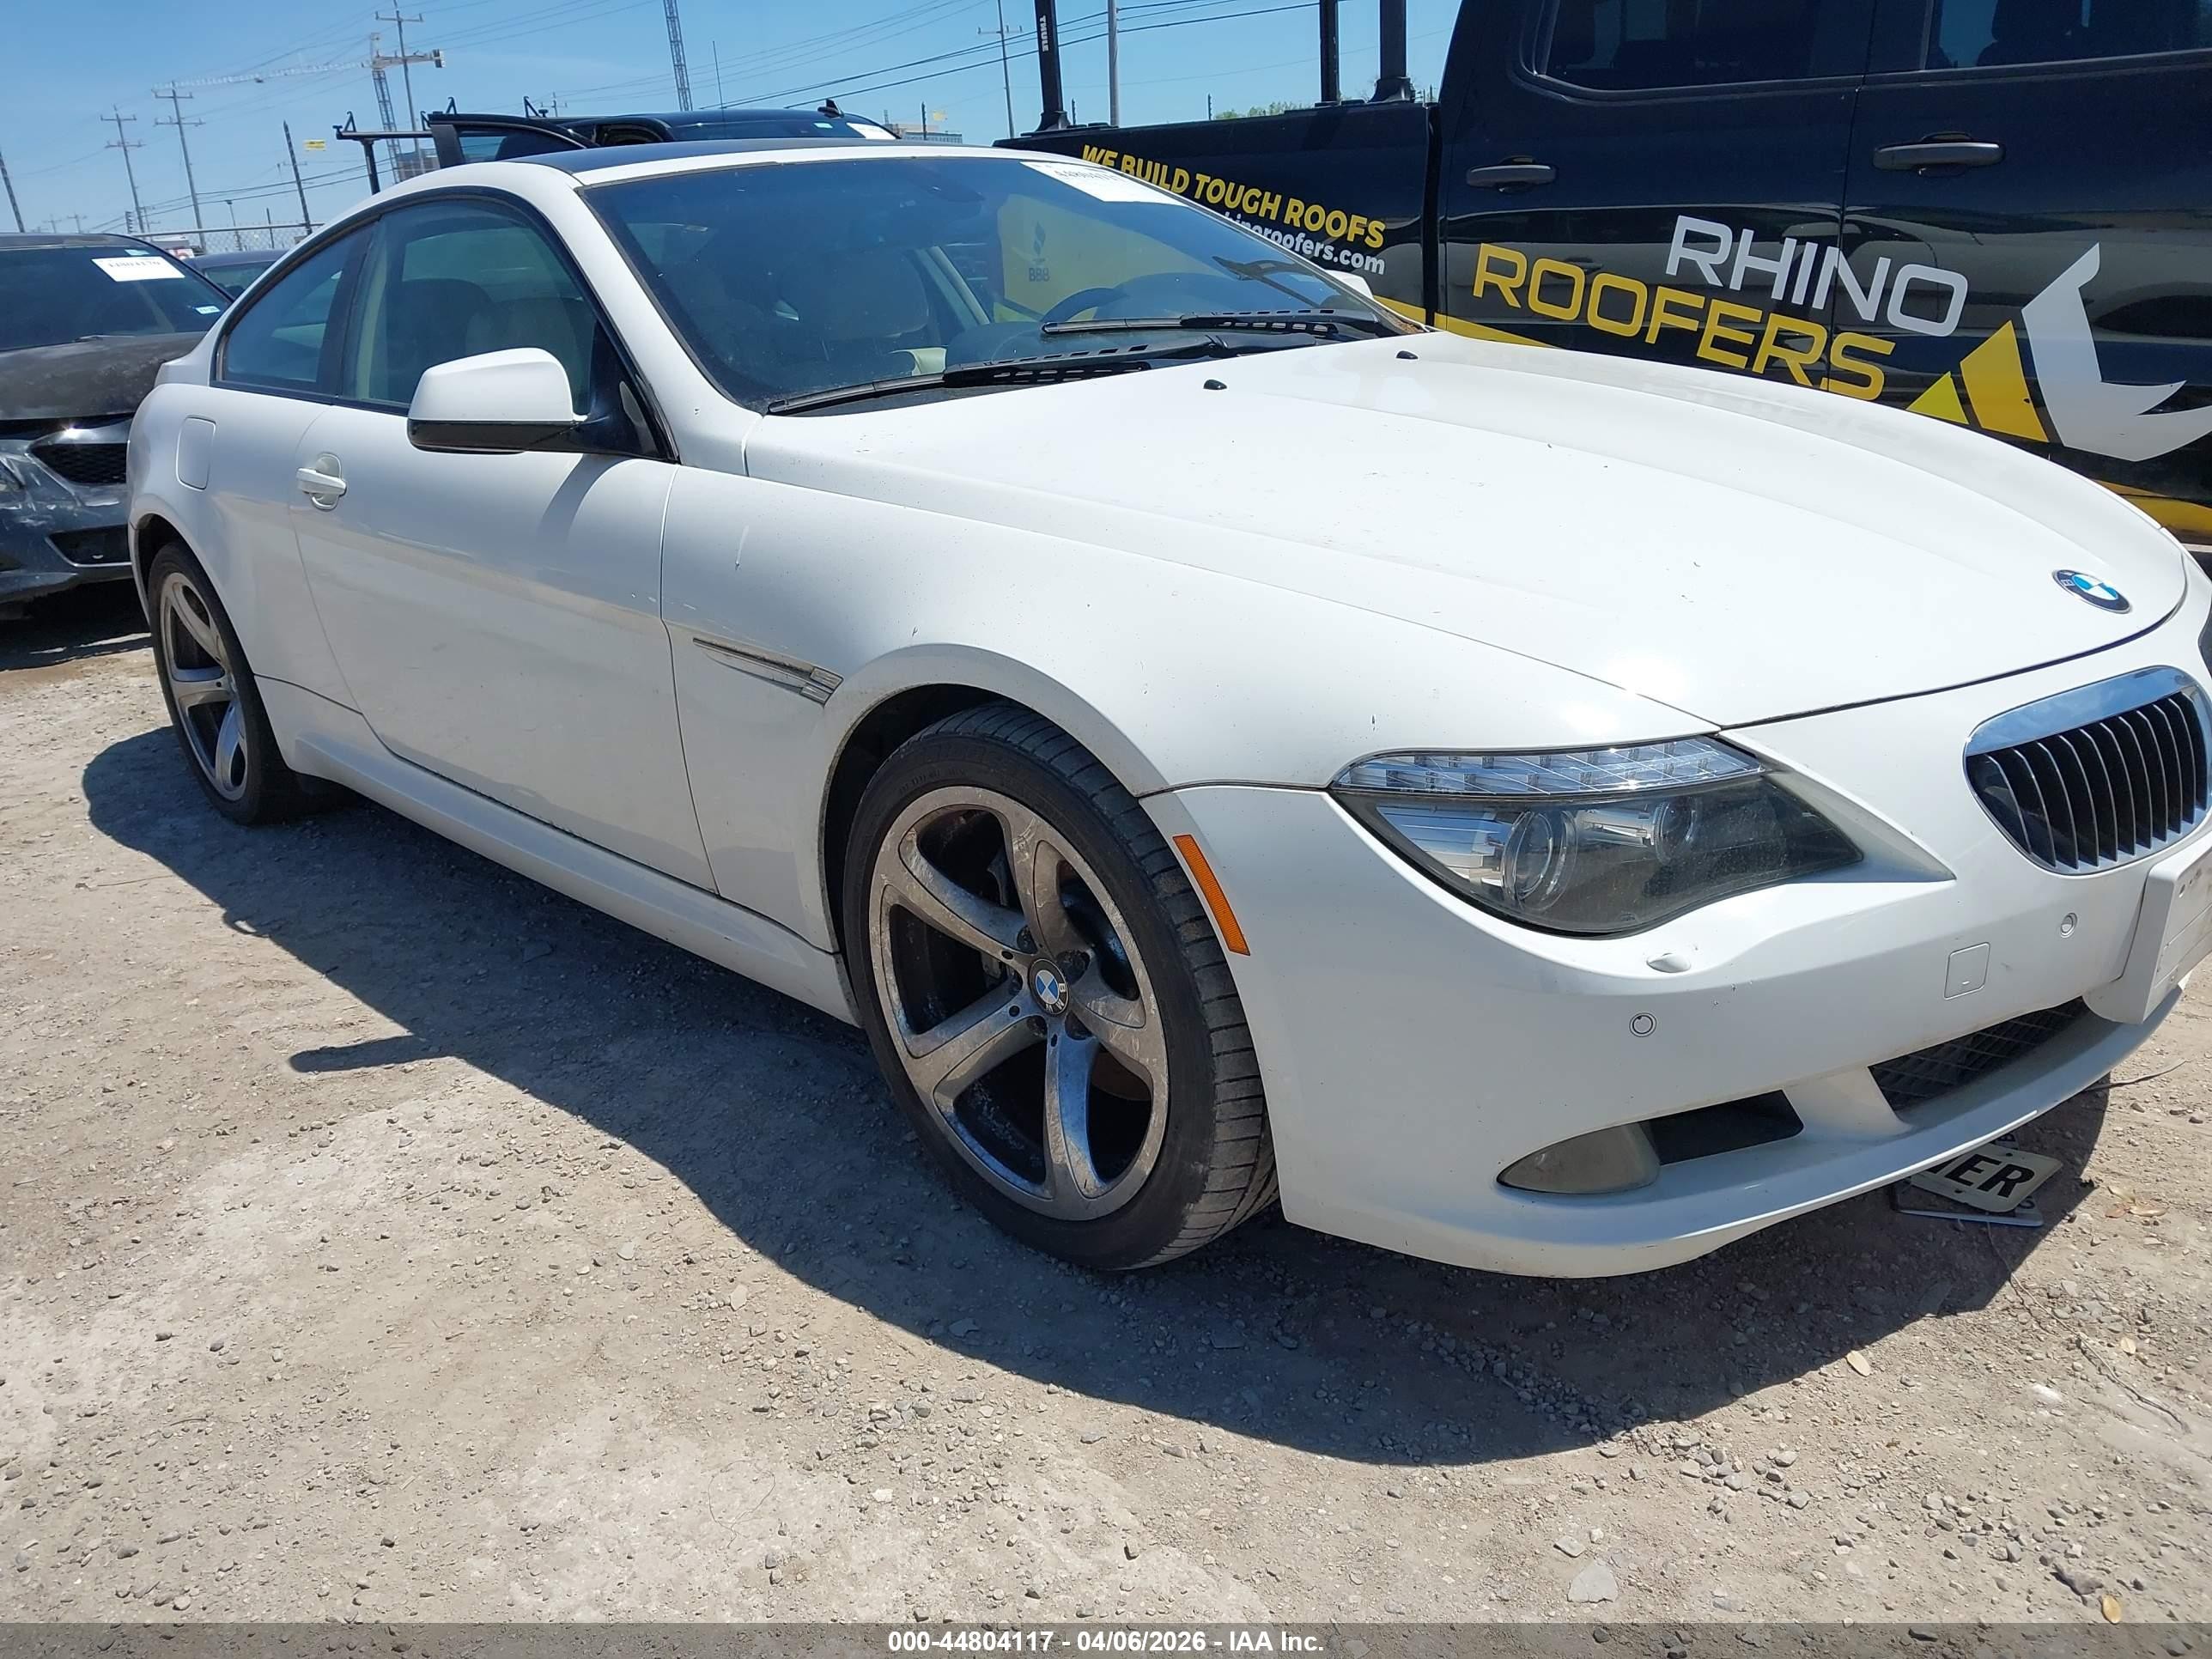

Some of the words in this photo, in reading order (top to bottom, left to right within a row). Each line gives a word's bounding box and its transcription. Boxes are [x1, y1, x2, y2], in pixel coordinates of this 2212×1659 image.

[1039, 15, 1049, 52] THULE
[1083, 144, 1118, 167] WE
[1121, 154, 1190, 194] BUILD
[1195, 173, 1281, 221] TOUGH
[1284, 198, 1386, 249] ROOFS
[1472, 242, 1896, 401] ROOFERS
[1664, 215, 1969, 337] RHINO
